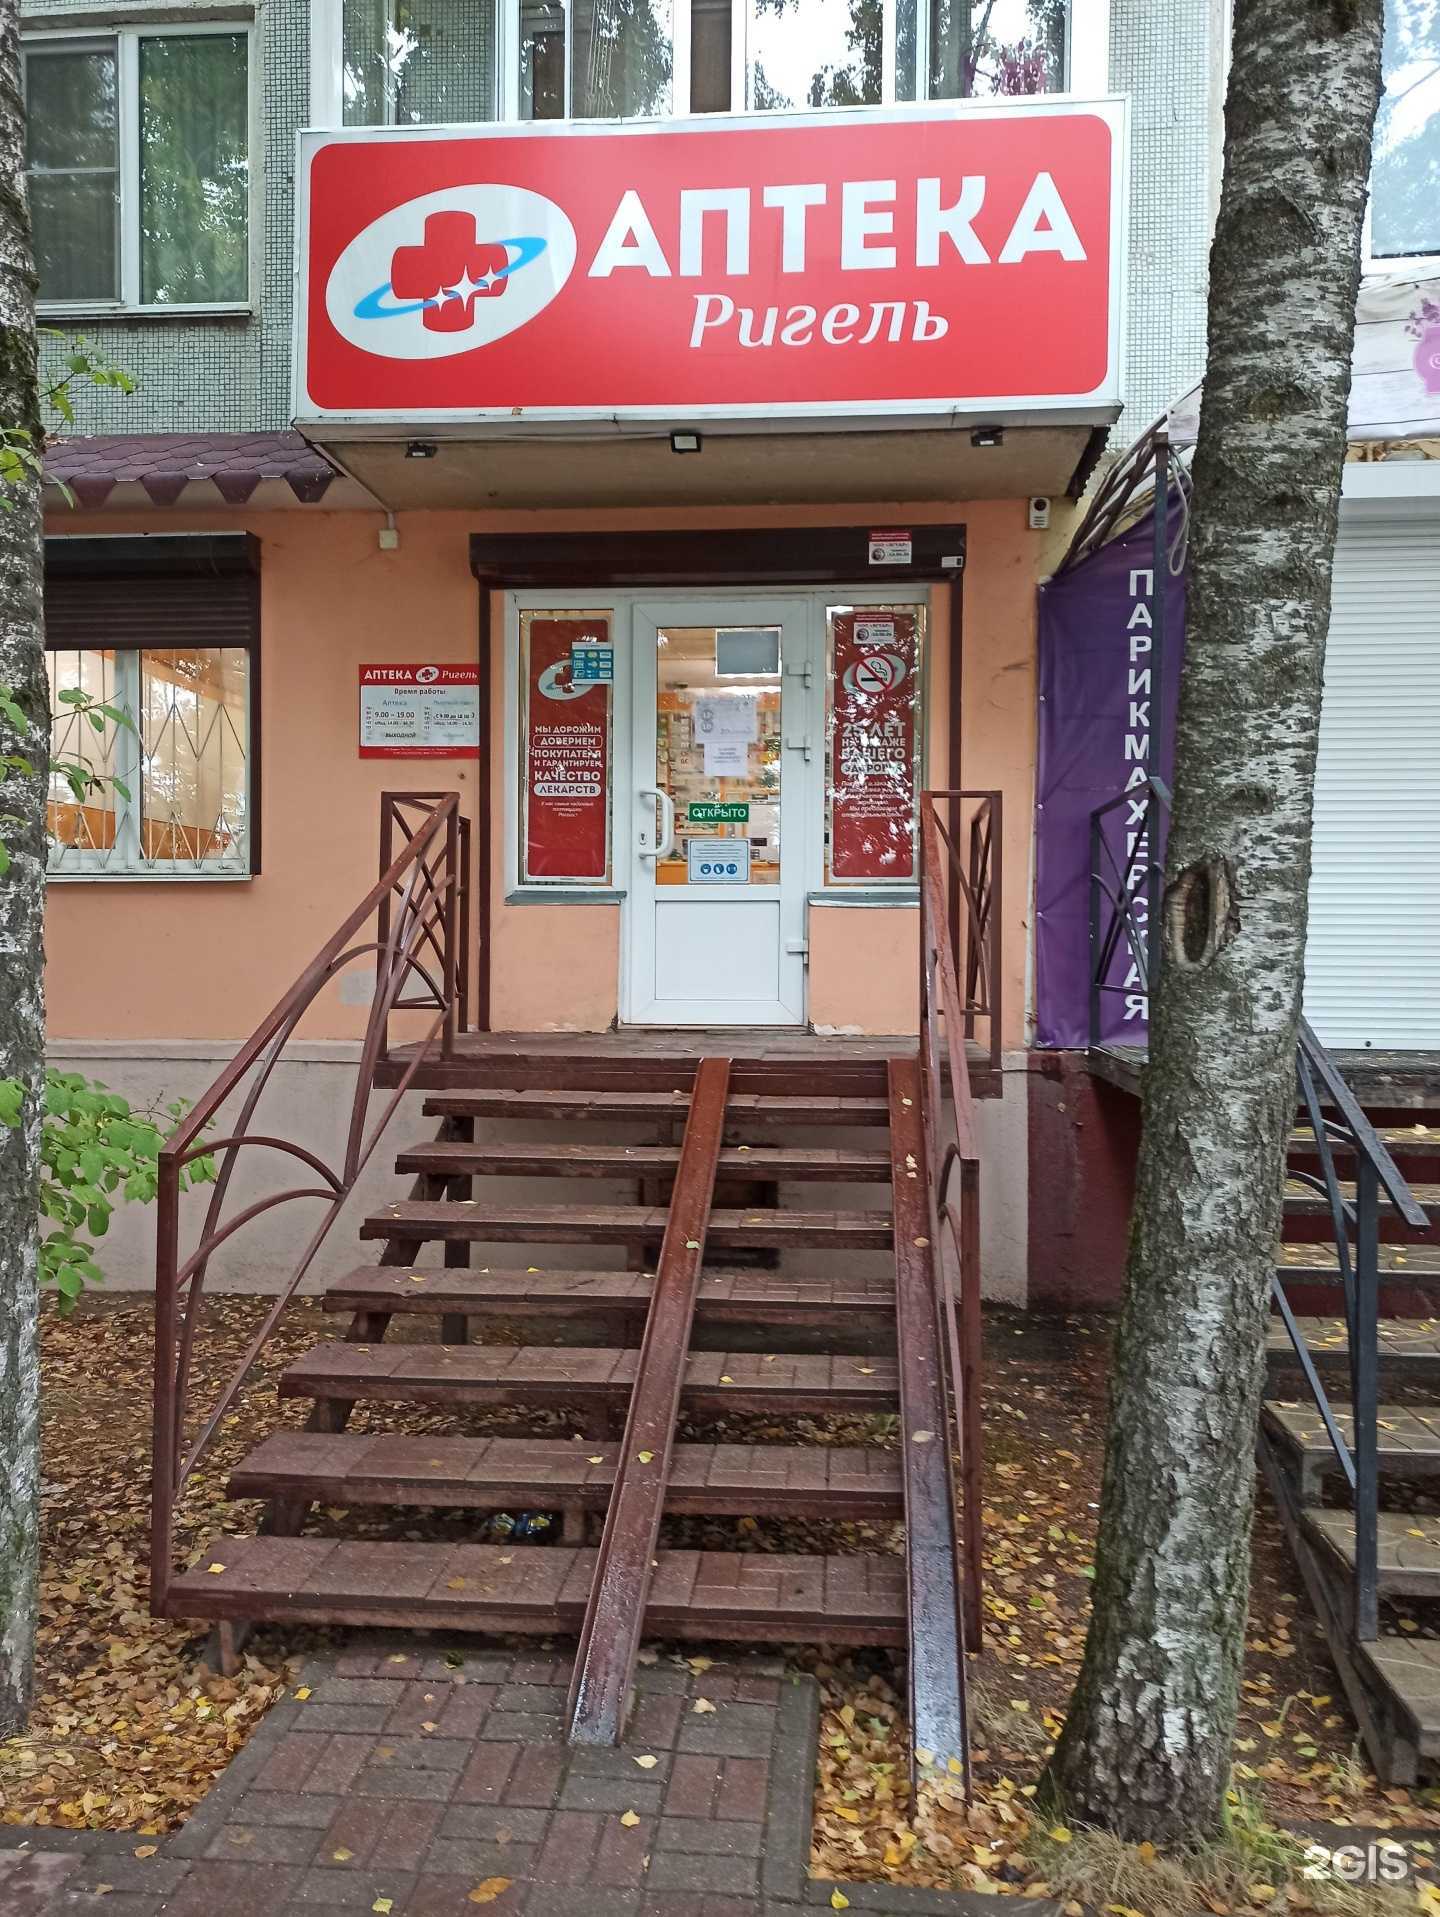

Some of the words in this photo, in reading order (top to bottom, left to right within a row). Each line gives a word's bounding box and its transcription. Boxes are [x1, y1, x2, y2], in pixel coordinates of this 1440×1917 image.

[588, 172, 1087, 278] АПТЕКА
[689, 293, 950, 348] Ригель
[364, 669, 413, 680] АПТЕКА
[442, 670, 478, 680] Ригель
[394, 687, 418, 696] Время
[419, 687, 447, 697] работы
[374, 711, 390, 719] 9.00
[535, 725, 551, 734] МЫ
[553, 725, 601, 734] ДОРОЖИМ
[870, 722, 906, 737] ЛЕТ
[540, 736, 596, 746] ДОВЕРИЕМ
[534, 759, 540, 767] И
[534, 770, 601, 781] КАЧЕСТВО
[540, 785, 596, 794] ЛЕКАРСТВ
[692, 807, 746, 819] ОТКРЫТО
